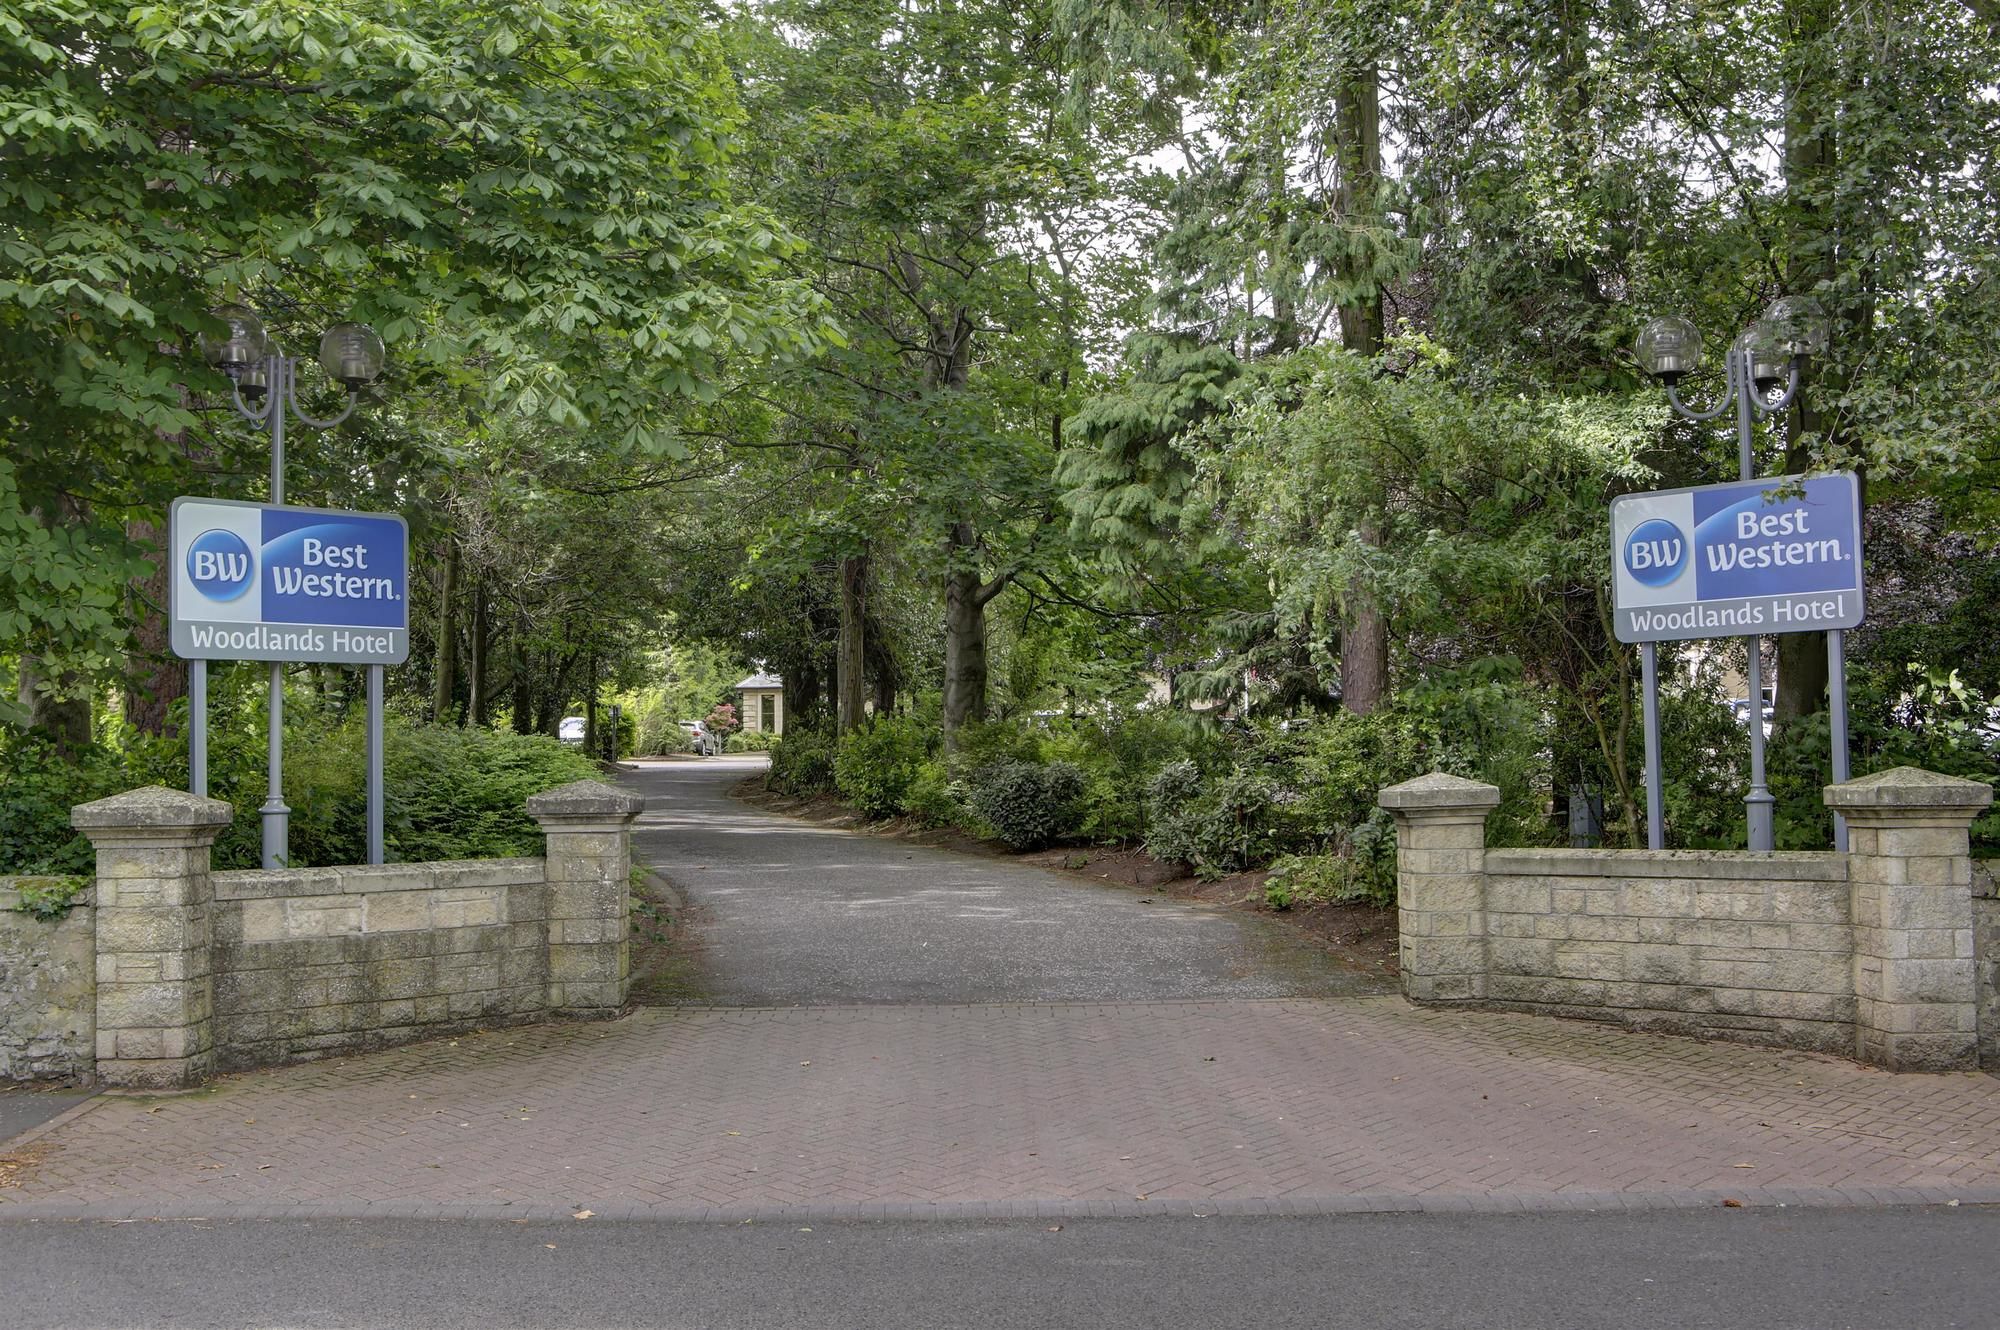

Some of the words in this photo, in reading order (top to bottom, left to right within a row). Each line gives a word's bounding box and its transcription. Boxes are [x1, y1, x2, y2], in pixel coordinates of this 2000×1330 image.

[1737, 508, 1810, 540] Best
[195, 551, 247, 583] BW
[303, 538, 368, 570] Best
[1631, 538, 1681, 570] BW
[1630, 602, 1764, 632] Woodlands
[1772, 594, 1845, 622] Hotel
[190, 625, 325, 652] Woodlands
[333, 631, 394, 654] Hotel
